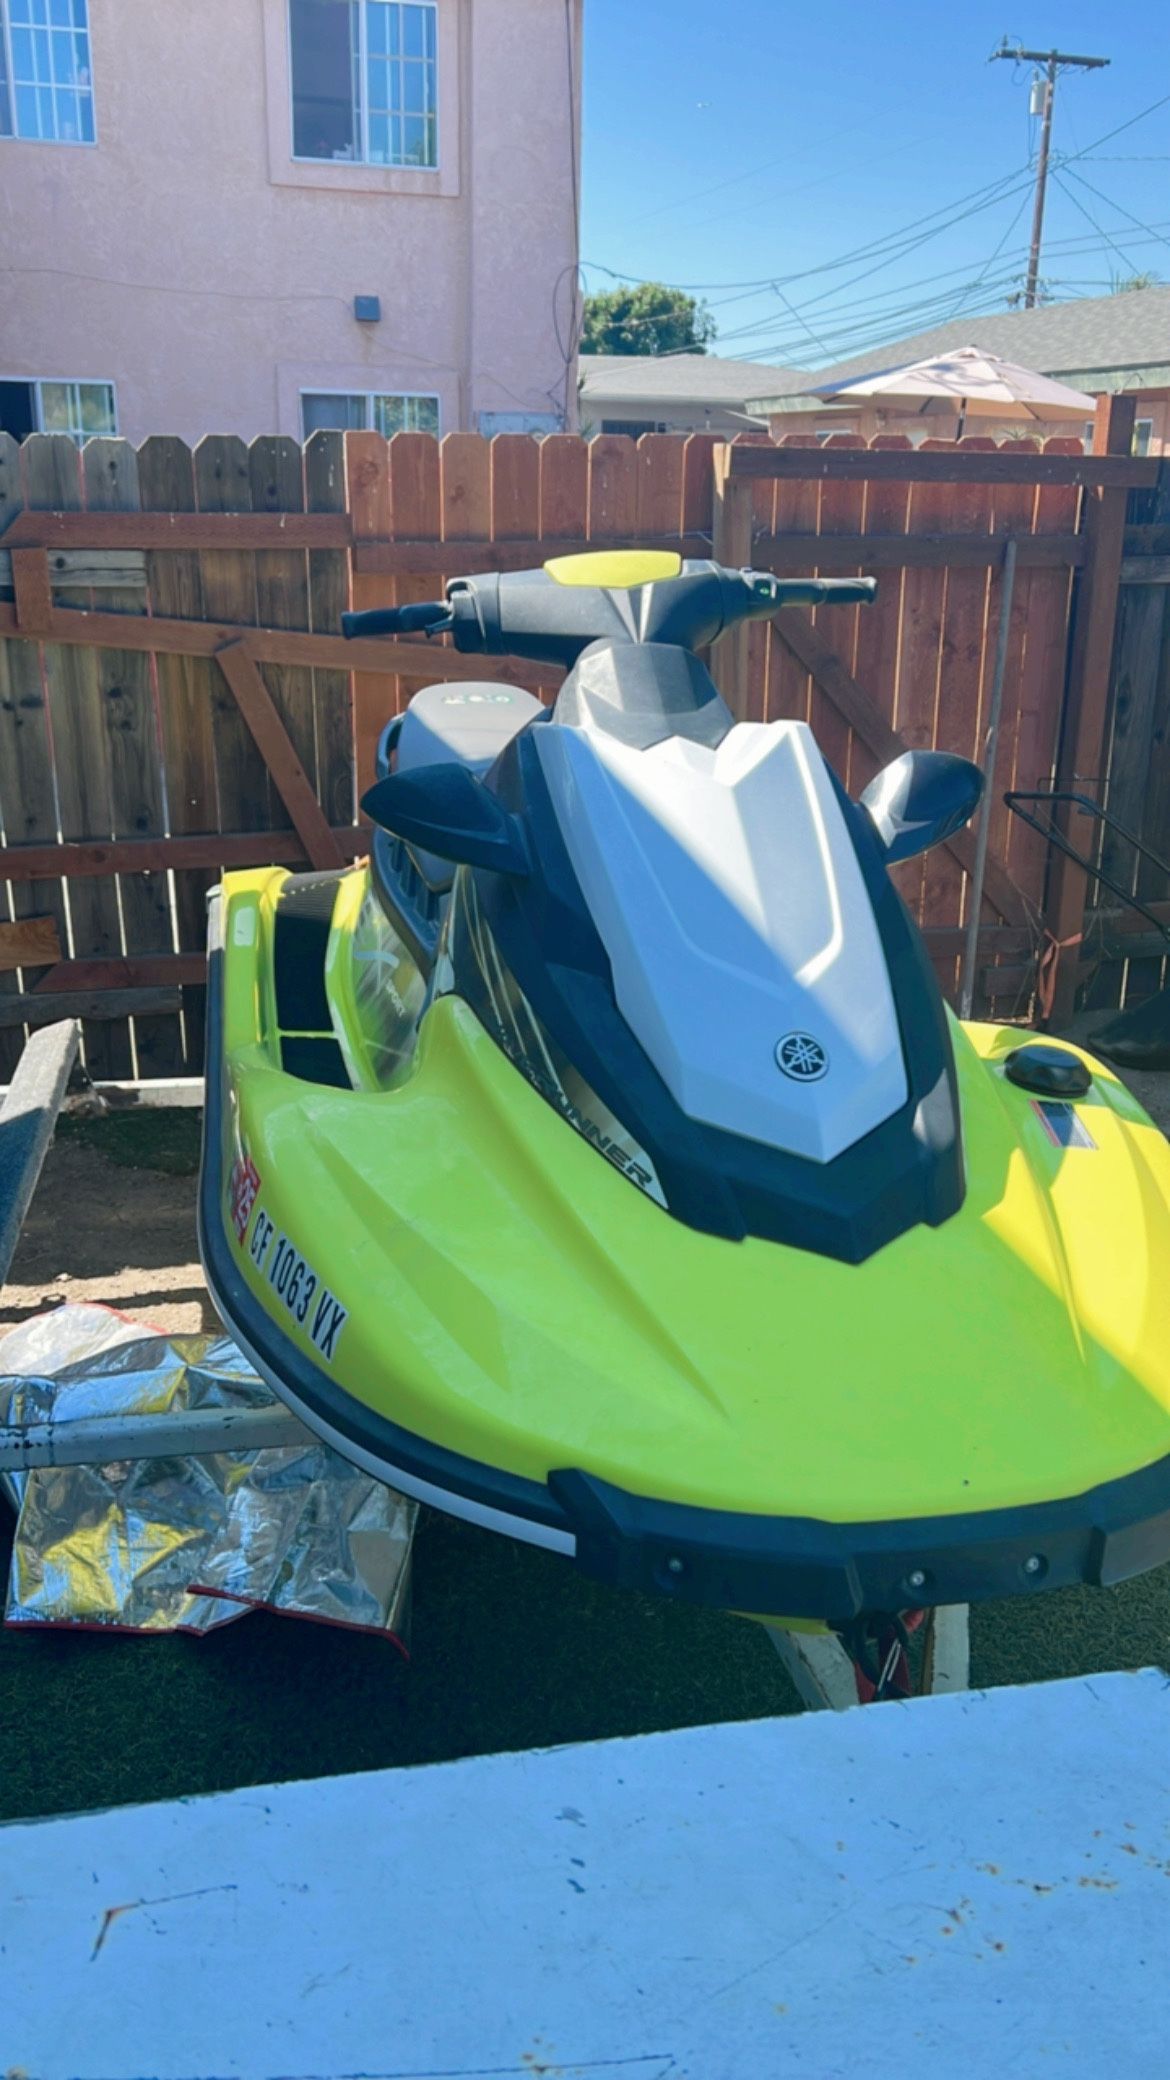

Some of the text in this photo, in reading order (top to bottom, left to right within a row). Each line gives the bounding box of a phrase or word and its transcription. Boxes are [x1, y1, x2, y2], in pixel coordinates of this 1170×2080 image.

[250, 1211, 346, 1361] CF 1063 VX
